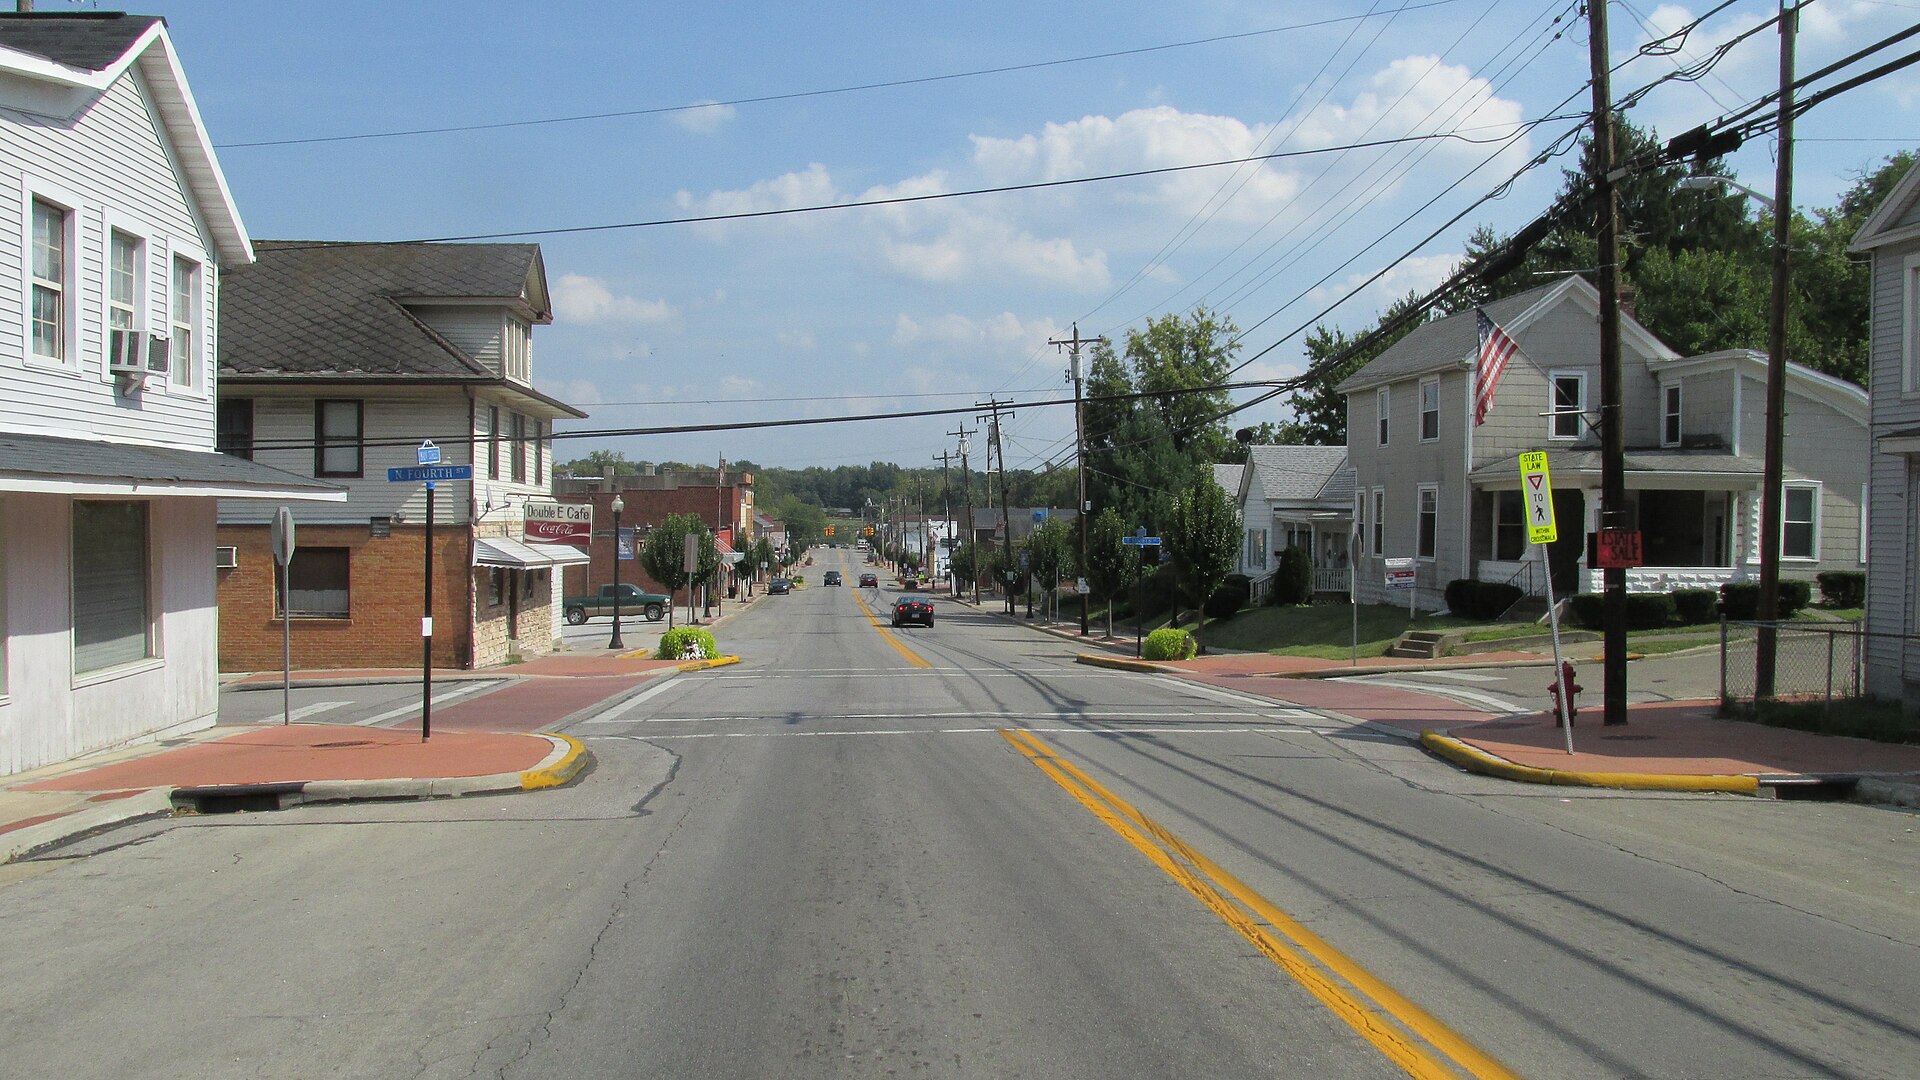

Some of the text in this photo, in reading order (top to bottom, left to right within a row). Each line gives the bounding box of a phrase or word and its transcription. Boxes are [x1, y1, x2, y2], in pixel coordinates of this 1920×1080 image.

[1523, 453, 1543, 462] STATE
[395, 470, 402, 480] N
[408, 468, 453, 479] FOURTH
[1533, 493, 1543, 502] TO
[527, 504, 590, 520] Double E Cafe
[1602, 531, 1638, 545] ESTATE
[1611, 546, 1638, 560] SALE
